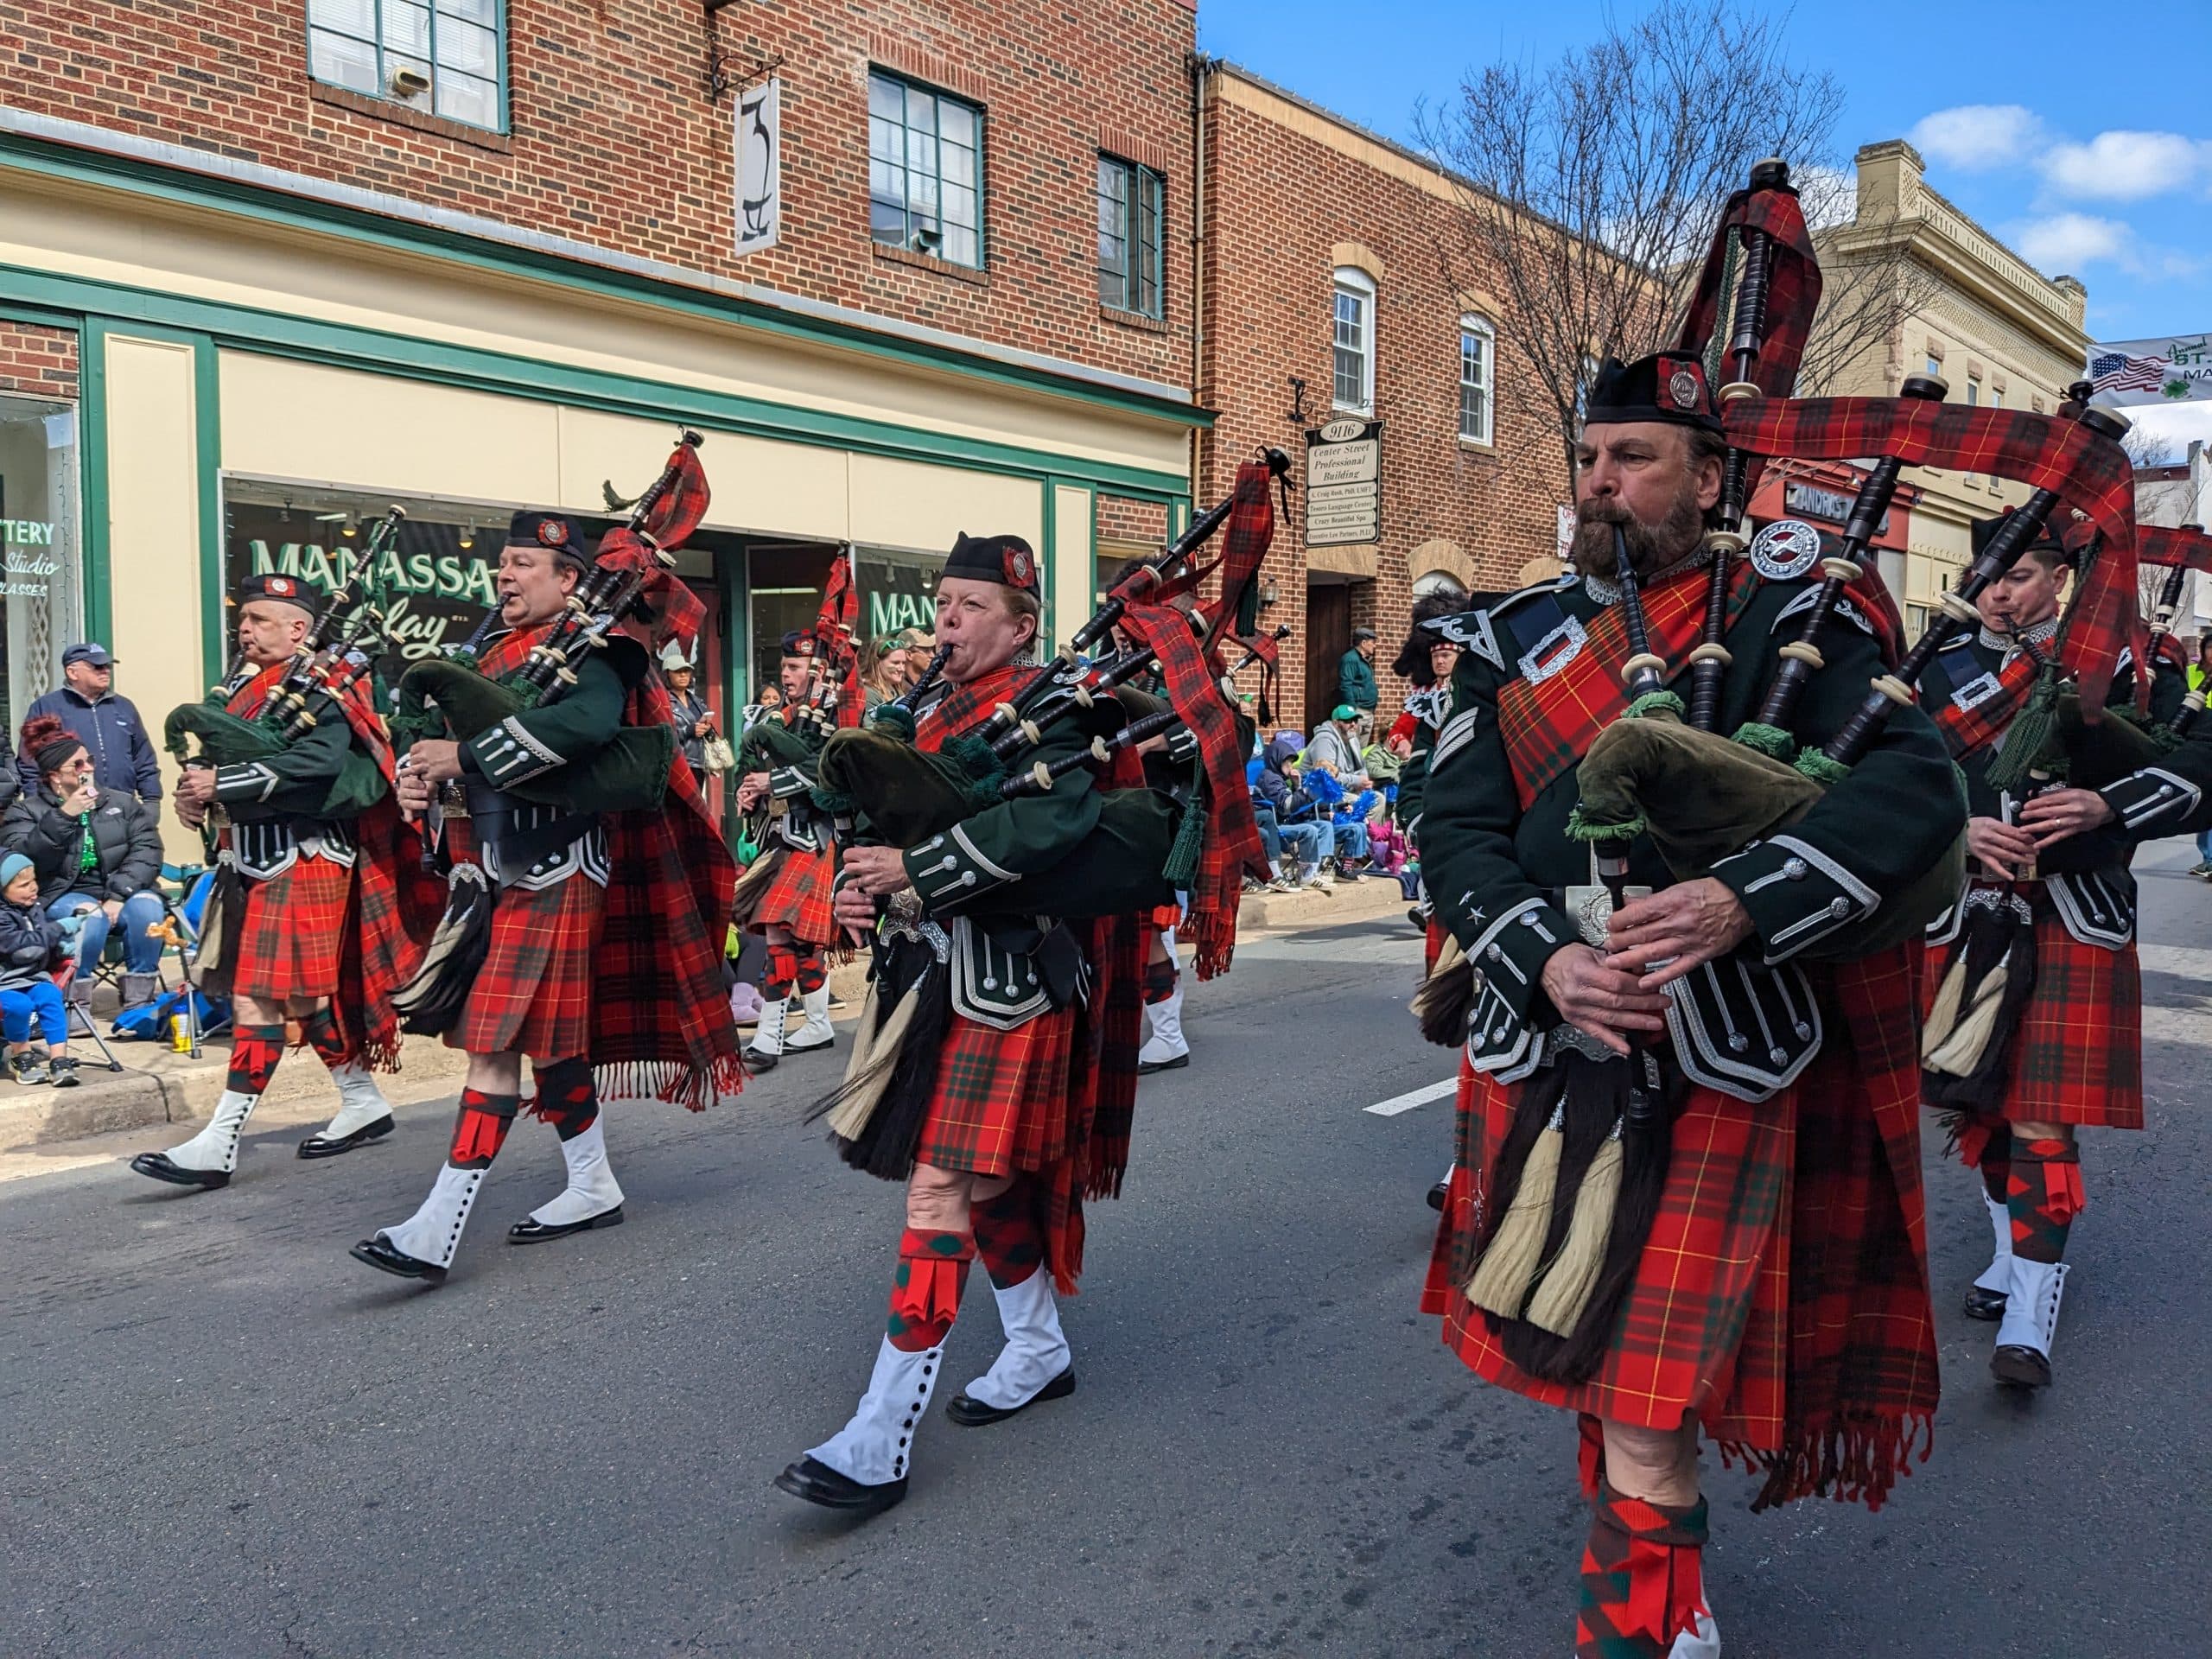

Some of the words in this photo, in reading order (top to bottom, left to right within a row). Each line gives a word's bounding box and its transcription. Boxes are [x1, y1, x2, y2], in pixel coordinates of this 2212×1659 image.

[2165, 336, 2207, 359] Annual
[1330, 423, 1356, 438] 9116
[1313, 448, 1341, 458] Center
[1344, 443, 1370, 454] Street
[1313, 455, 1365, 470] Professional
[1323, 470, 1360, 481] Building
[1331, 515, 1355, 524] Beautiful
[1356, 514, 1366, 523] Spa
[0, 550, 60, 575] Studio
[342, 596, 448, 660] Clay
